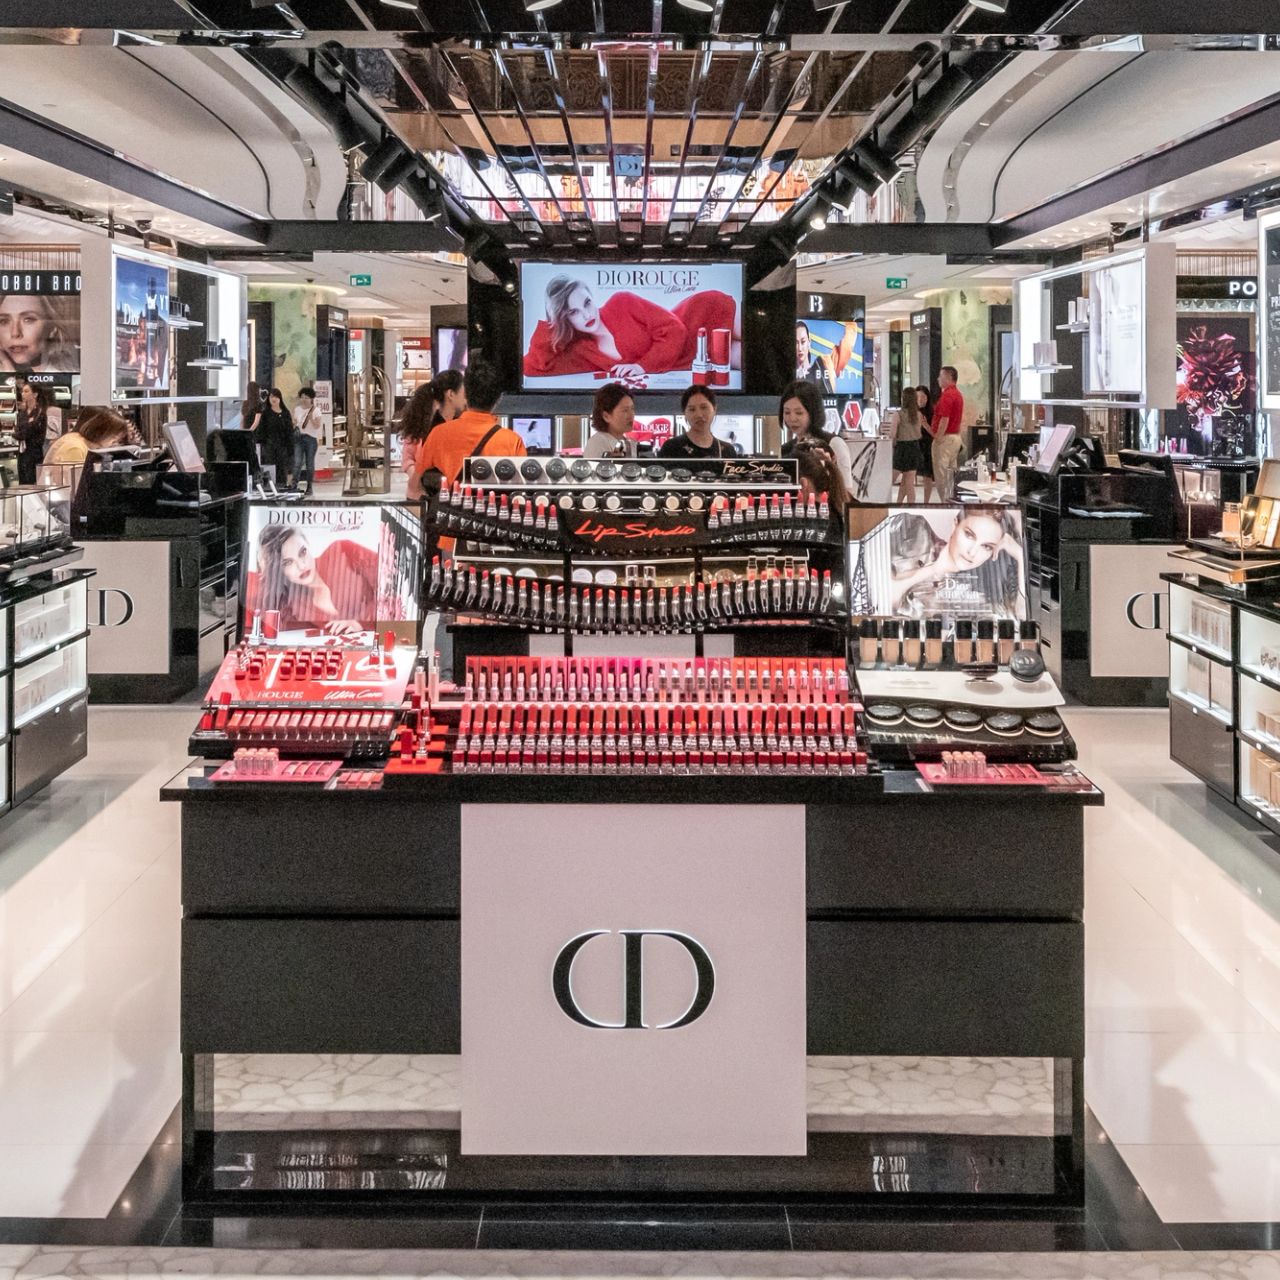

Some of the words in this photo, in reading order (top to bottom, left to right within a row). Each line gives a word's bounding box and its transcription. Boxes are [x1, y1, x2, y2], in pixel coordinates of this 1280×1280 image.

[597, 270, 700, 286] DIOROUGE
[1229, 281, 1257, 295] PO
[27, 375, 54, 383] COLOR
[723, 461, 747, 474] Face
[748, 460, 784, 473] Studio
[268, 510, 365, 526] DIOROUGE
[574, 519, 623, 542] Lip
[624, 523, 697, 538] Studio
